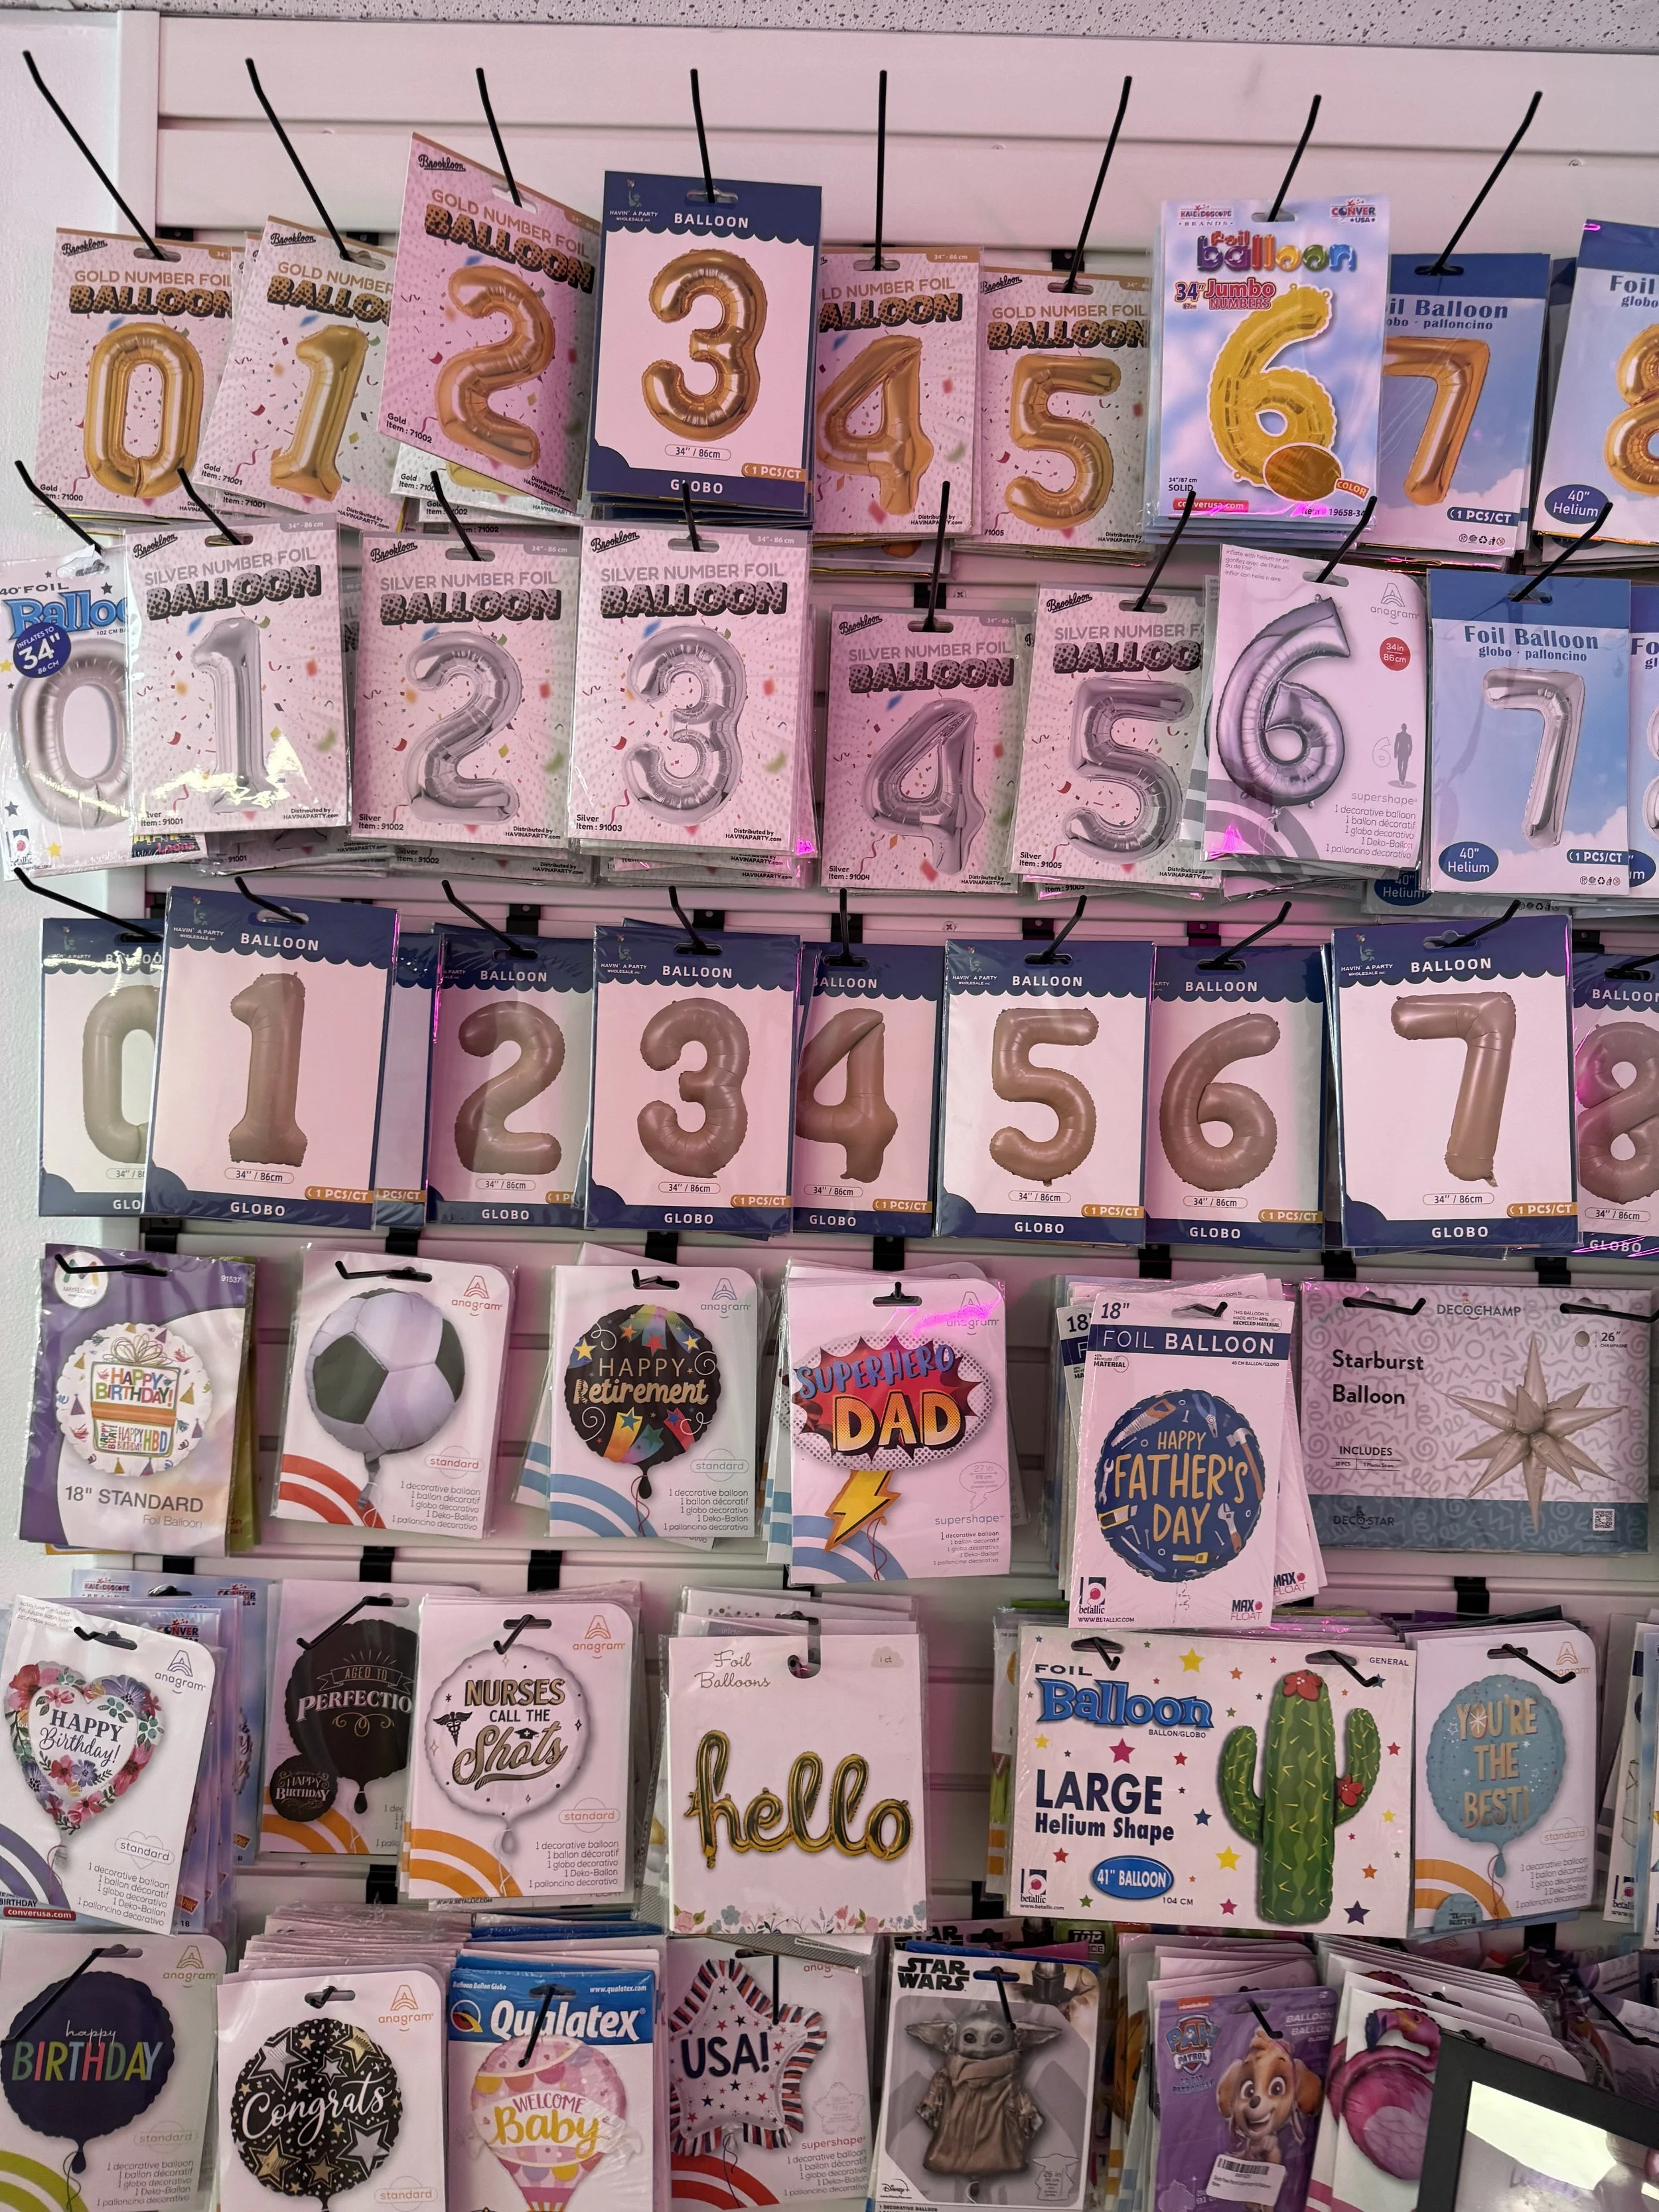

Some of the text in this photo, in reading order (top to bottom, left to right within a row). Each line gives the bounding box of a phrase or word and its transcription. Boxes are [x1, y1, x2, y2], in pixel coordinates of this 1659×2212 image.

[431, 190, 590, 259] GOLD NUMBER FOIL
[674, 213, 749, 229] BALLOON
[1211, 230, 1250, 246] Foil
[62, 240, 108, 256] Brookloon
[424, 204, 596, 295] BALLOON
[1197, 234, 1357, 272] balloon
[74, 270, 195, 285] GOLD NUMBER
[277, 261, 323, 279] GOLD
[1204, 278, 1275, 299] Jumbo
[1610, 275, 1655, 293] Foil
[69, 285, 232, 317] BALLOON
[1209, 297, 1271, 310] NUMBERS
[1415, 299, 1508, 319] Balloon
[992, 305, 1147, 319] GOLD NUMBER FOIL
[1423, 320, 1493, 330] palloncino
[760, 466, 802, 480] PCS/CT
[1336, 480, 1367, 496] COLOR
[1466, 511, 1512, 524] PCS/CT
[1553, 502, 1599, 517] Helium
[133, 533, 178, 559] Brookloon
[144, 547, 316, 587] SILVER NUMBER FOIL
[601, 563, 784, 583] SILVER NUMBER FOIL
[24, 583, 69, 593] FOIL
[380, 571, 558, 591] SILVER NUMBER FOIL
[145, 564, 322, 621] BALLOON
[600, 581, 788, 619] BALLOON
[380, 588, 561, 626] BALLOON
[1370, 605, 1417, 621] anagram
[17, 631, 45, 649] INFLATES
[1054, 625, 1183, 640] SILVER NUMBER
[1464, 625, 1599, 650] Foil Balloon
[849, 641, 1011, 662] SILVER NUMBER FOIL
[1386, 642, 1404, 652] 34in
[1479, 646, 1587, 662] globo palloncino
[47, 660, 59, 670] CM
[848, 658, 1014, 694] BALLOON
[1351, 792, 1413, 807] supershape
[358, 814, 382, 822] Silver
[1447, 859, 1490, 873] Helium
[240, 933, 319, 950] BALLOON
[662, 966, 733, 978] BALLOON
[1411, 958, 1492, 973] BALLOON
[480, 970, 547, 982] BALLOON
[1012, 976, 1082, 988] BALLOON
[1185, 982, 1258, 992] BALLOON
[230, 1202, 285, 1217] GLOBO
[1015, 1222, 1064, 1234] GLOBO
[1189, 1227, 1241, 1240] GLOBO
[1431, 1226, 1488, 1238] GLOBO
[221, 1275, 241, 1284] 91537
[1437, 1303, 1521, 1317] DECOCHAMP
[1103, 1330, 1274, 1354] FOIL BALLOON
[599, 1358, 685, 1376] HAPPY
[1333, 1349, 1424, 1371] Starburst
[111, 1368, 164, 1388] HAPPY
[796, 1344, 956, 1399] SUPERHERO
[96, 1383, 173, 1407] BIRTHDAY!
[573, 1378, 709, 1405] Retirement
[1333, 1384, 1405, 1404] Balloon
[832, 1388, 966, 1456] DAD
[143, 1430, 167, 1453] HBD
[1157, 1430, 1206, 1450] HAPPY
[1339, 1446, 1392, 1456] INCLUDES
[430, 1458, 478, 1469] standard
[1115, 1453, 1248, 1504] FATHER'S
[98, 1489, 204, 1512] STANDARD
[1153, 1503, 1210, 1545] DAY
[1232, 1599, 1254, 1612] MAX
[1230, 1611, 1263, 1621] FLOAT
[713, 1649, 752, 1668] Foil
[1369, 1657, 1409, 1666] GENERAL
[345, 1666, 387, 1680] AGED TO
[1035, 1664, 1093, 1676] FOIL
[694, 1672, 770, 1689] Balloons
[465, 1678, 565, 1707] NURSES
[1035, 1678, 1214, 1728] Balloon
[489, 1710, 550, 1722] CALL THE
[1457, 1694, 1538, 1739] YOU'RE
[50, 1709, 124, 1742] HAPPY
[1148, 1729, 1206, 1739] BALLON/GLOBO
[39, 1726, 121, 1764] Birthday!
[452, 1721, 568, 1791] Shots
[1473, 1742, 1519, 1781] THE
[287, 1776, 323, 1788] HAPPY
[275, 1787, 330, 1801] BIRTHDAY
[684, 1730, 913, 1869] hello
[1037, 1769, 1163, 1814] LARGE
[564, 1810, 615, 1821] standard
[1035, 1813, 1174, 1846] Helium Shape
[581, 1848, 619, 1858] décoratif
[553, 1861, 575, 1871] globo
[535, 1880, 574, 1889] palloncino
[1118, 1870, 1166, 1887] BALLOON
[7, 1909, 72, 1919] converusa.com
[906, 1957, 970, 1975] STAR
[590, 1984, 647, 1994] www.qualatex.com
[897, 1972, 969, 1991] WARS
[490, 2000, 640, 2041] Qualatex
[66, 2020, 117, 2047] happy
[1165, 2023, 1220, 2053] PAW
[11, 2041, 163, 2081] BIRTHDAY
[681, 2032, 769, 2078] USA!
[1178, 2052, 1207, 2067] PATROL
[243, 2071, 392, 2144] Congrats
[512, 2091, 586, 2114] WELCOME
[492, 2105, 601, 2160] Baby
